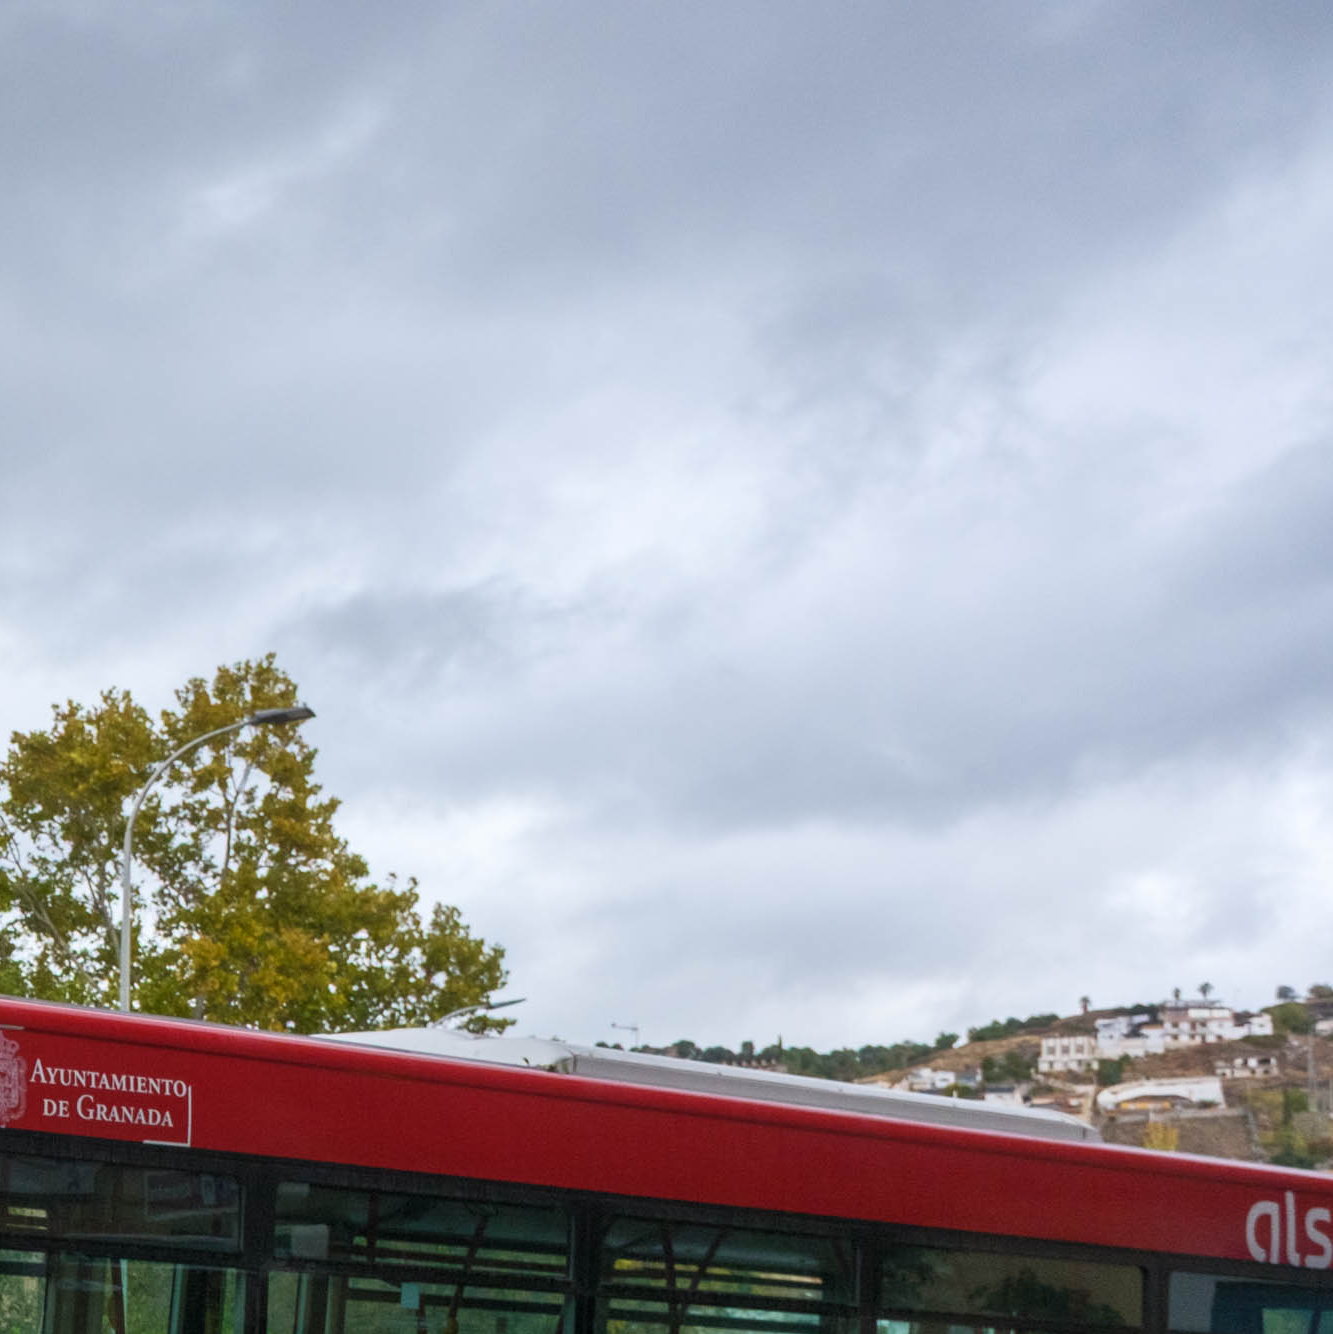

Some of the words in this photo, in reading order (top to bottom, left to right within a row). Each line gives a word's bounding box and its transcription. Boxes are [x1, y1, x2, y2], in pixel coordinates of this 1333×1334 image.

[29, 1058, 187, 1098] AYUNTAMIENTO
[42, 1098, 70, 1118] DE
[76, 1094, 174, 1127] GRANADA
[1245, 1189, 1333, 1270] als
